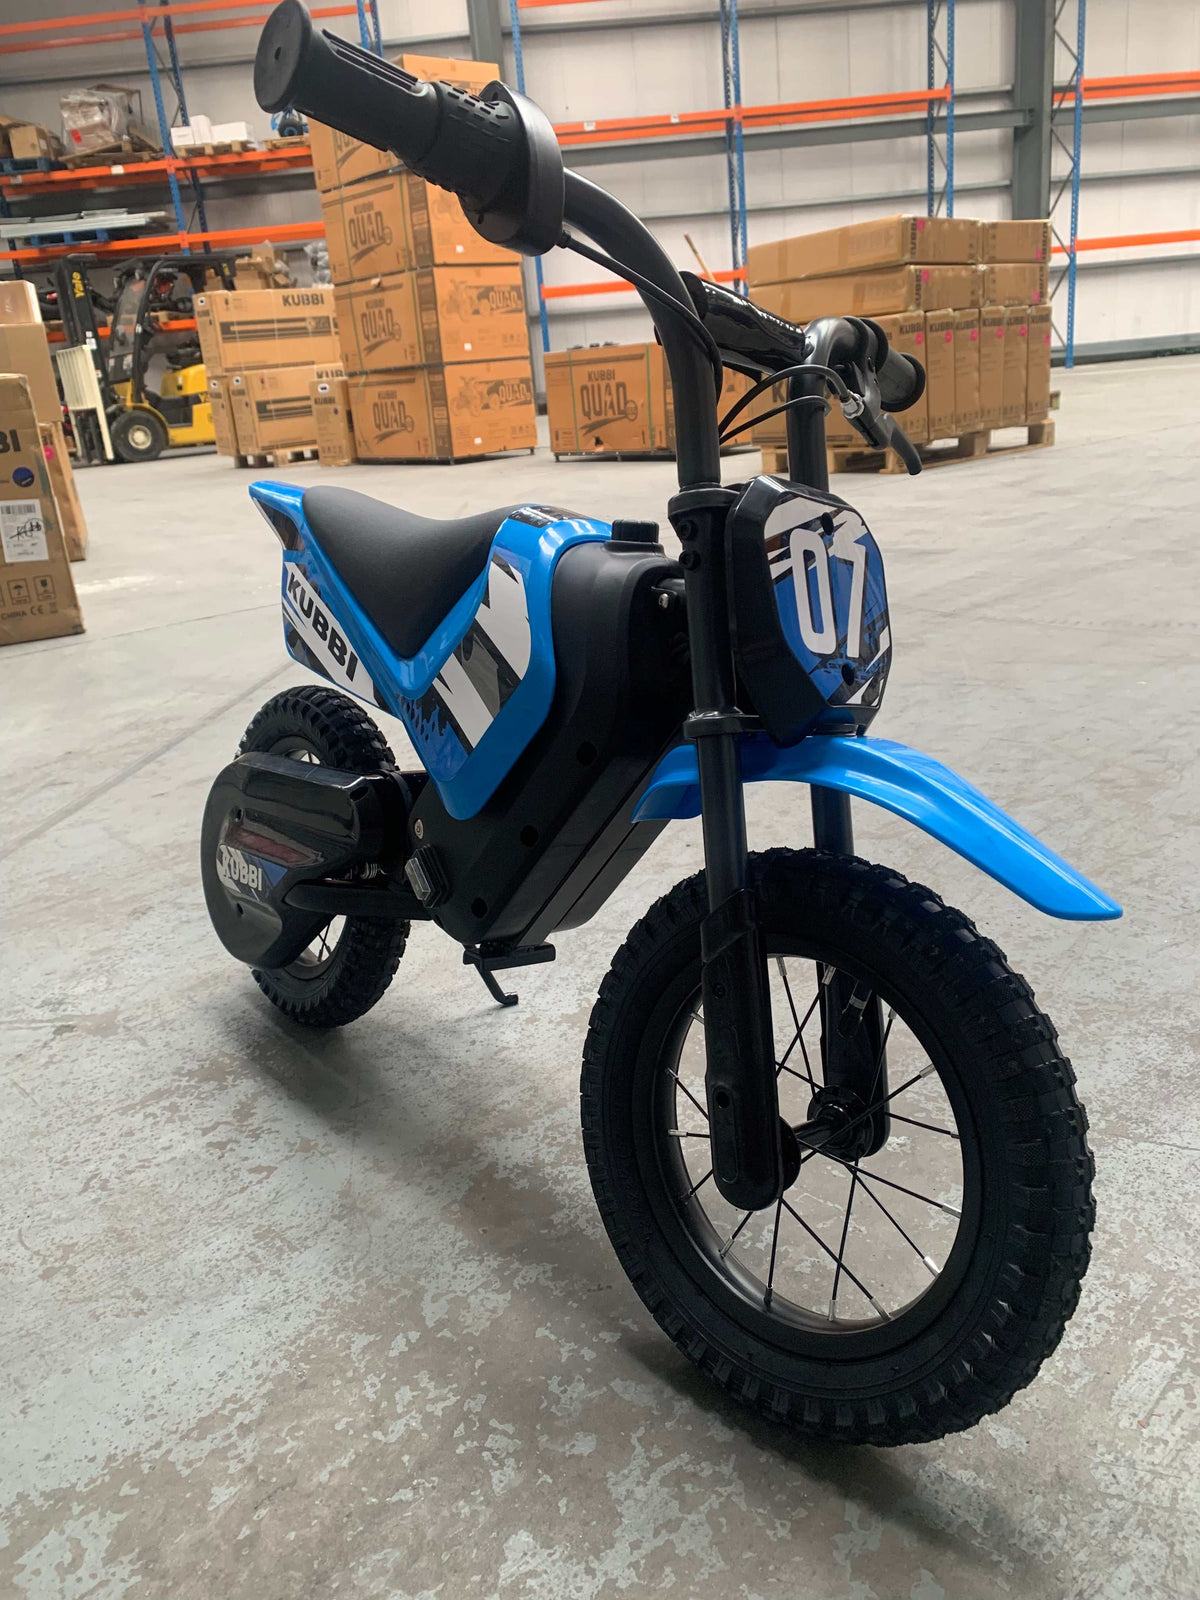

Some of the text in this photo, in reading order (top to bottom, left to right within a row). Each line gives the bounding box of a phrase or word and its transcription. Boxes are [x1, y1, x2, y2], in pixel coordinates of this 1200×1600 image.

[349, 210, 384, 249] QUAD
[72, 271, 85, 298] Yale
[282, 293, 325, 307] KUBBI
[361, 308, 395, 342] QUAD
[587, 368, 615, 382] KUBBI
[372, 400, 407, 431] QUAD
[580, 382, 628, 420] QUAD
[790, 527, 867, 658] 07
[287, 571, 359, 682] KUBBI
[219, 845, 263, 891] KUBBI
